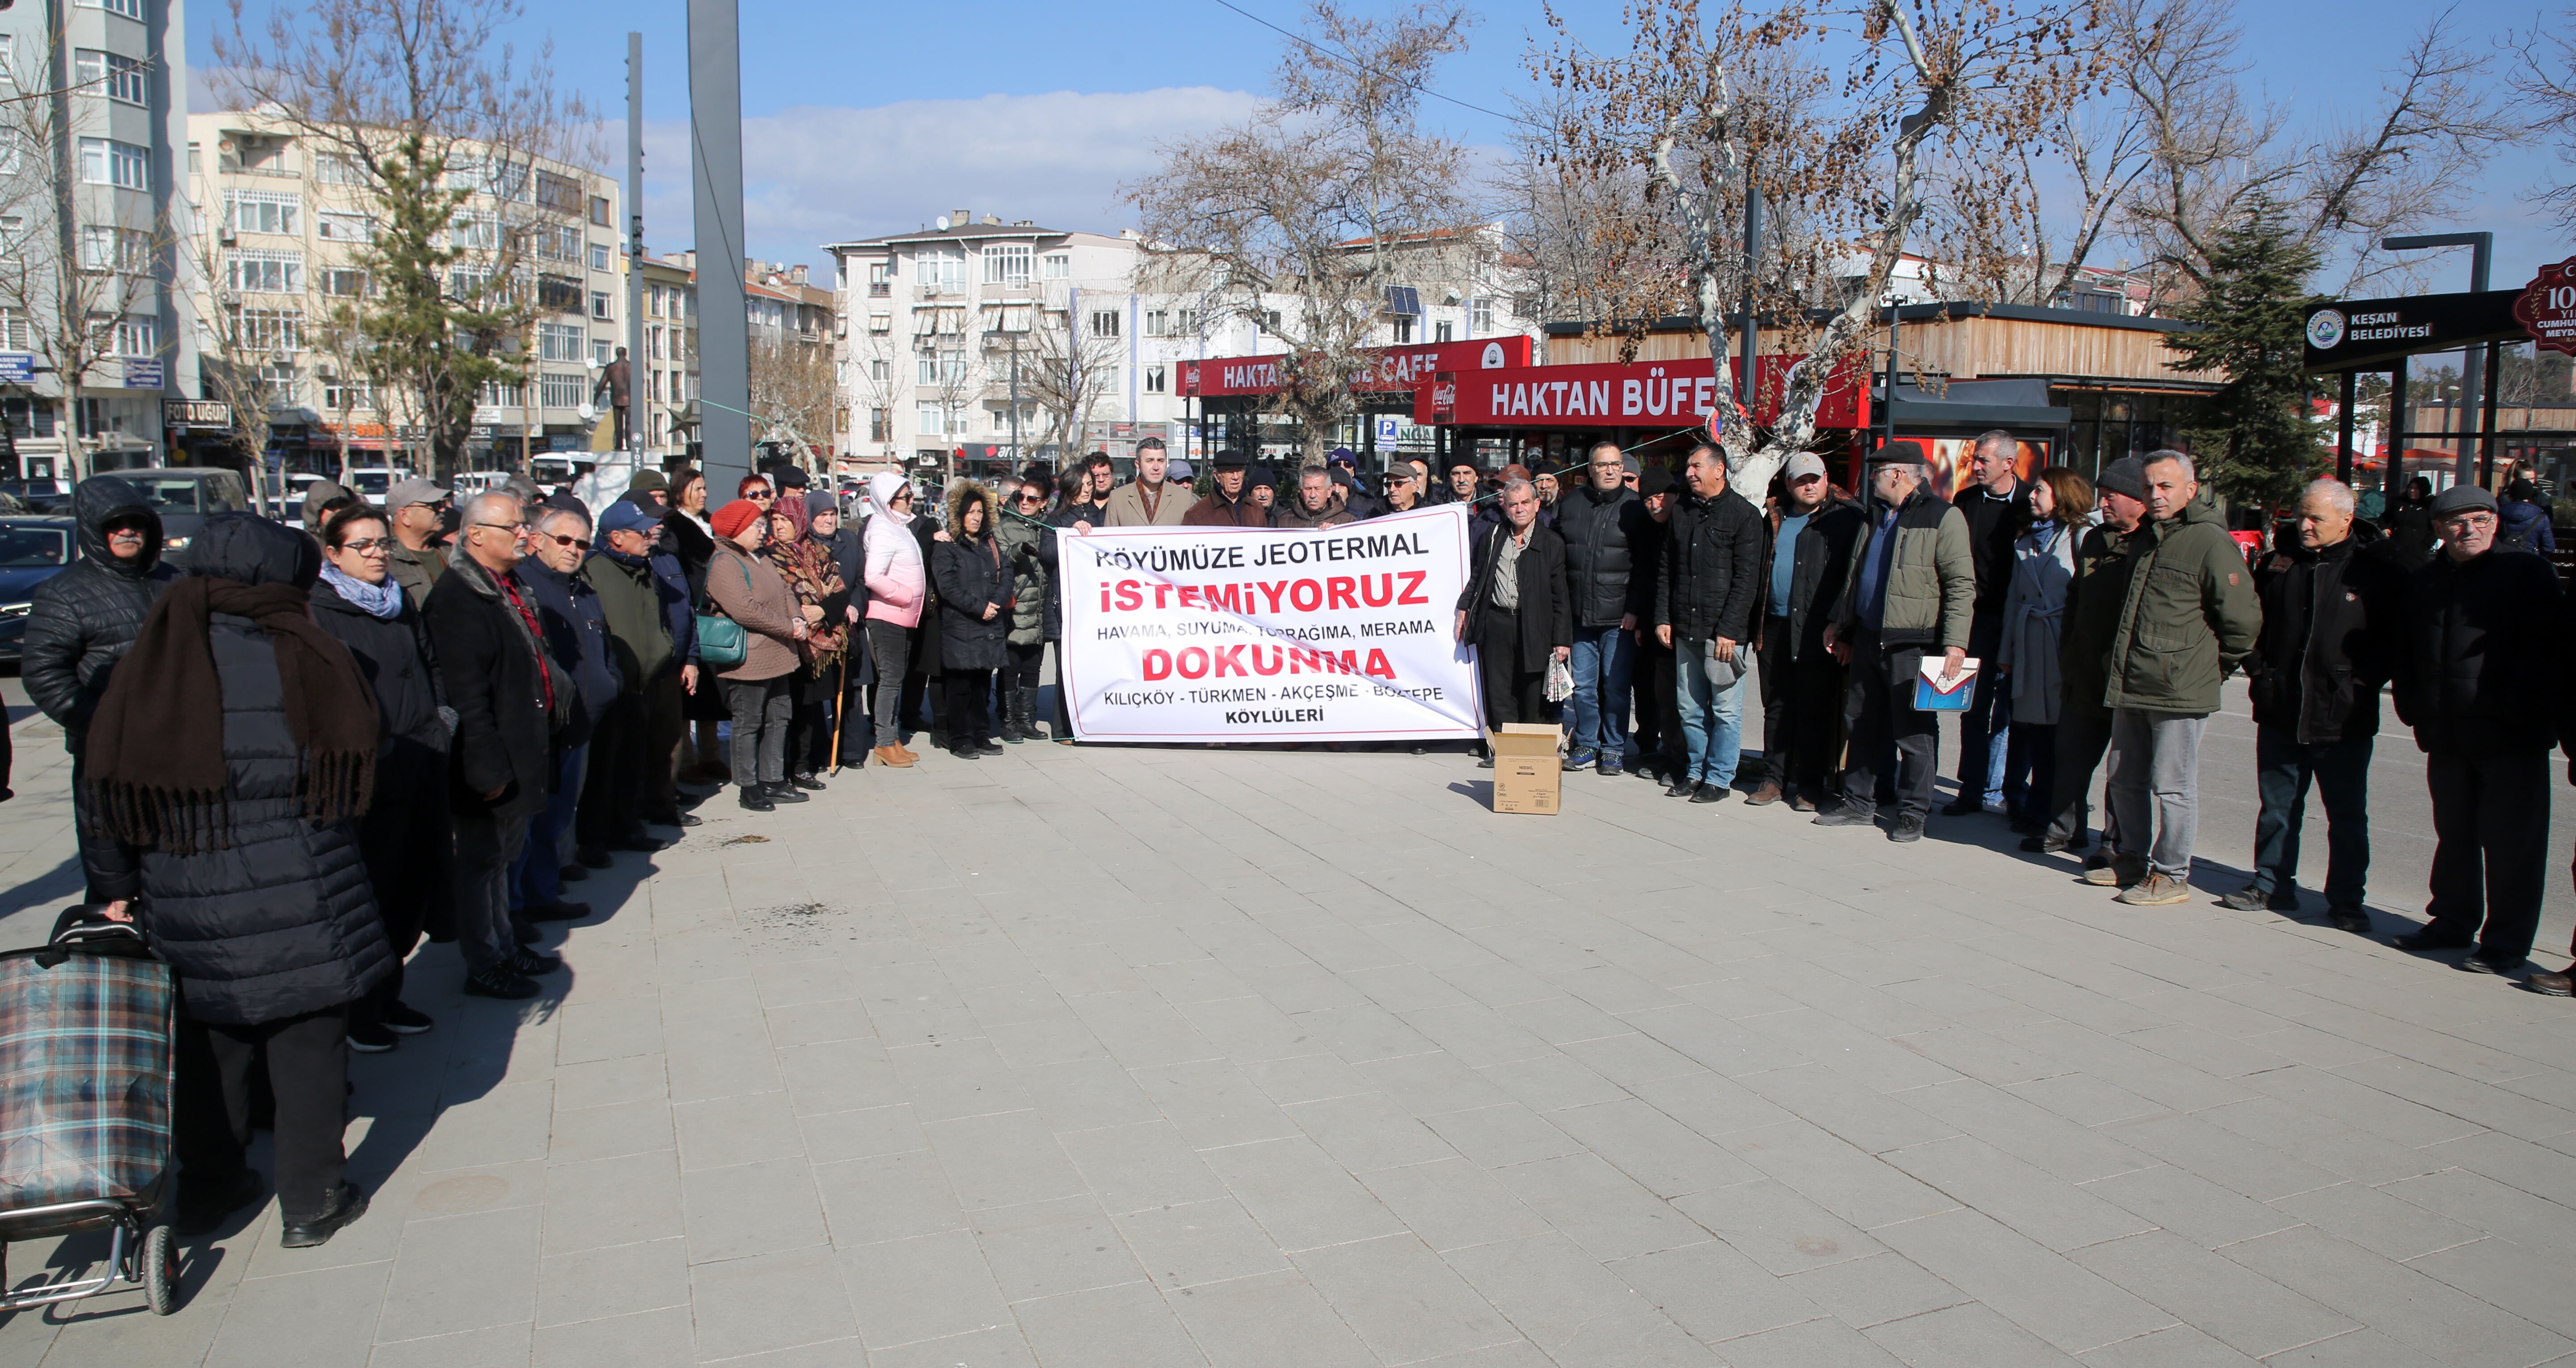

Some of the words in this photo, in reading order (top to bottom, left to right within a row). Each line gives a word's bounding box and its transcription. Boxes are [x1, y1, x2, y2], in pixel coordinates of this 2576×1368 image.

[2351, 312, 2397, 326] KEŞAN
[2561, 310, 2576, 319] YI
[2351, 323, 2430, 340] BELEDİYESİ
[2537, 319, 2576, 329] CUMHU
[1224, 364, 1289, 388] HAKTA
[1491, 380, 1610, 416] HAKTAN
[1622, 367, 1716, 416] BÜFE
[167, 404, 195, 421] FOTO
[1383, 422, 1393, 435] P
[1095, 544, 1245, 572] KÖYÜMÜZE
[1254, 532, 1429, 566] JEOTERMAL
[1360, 620, 1436, 637] MERAMA
[1142, 643, 1397, 681] DOKUNMA
[1104, 689, 1175, 708] KILIÇKÖY
[1189, 687, 1266, 704] TÜRKMEN
[1280, 684, 1359, 702] AKÇEŞME
[1225, 705, 1324, 724] KÖYLÜLERİ
